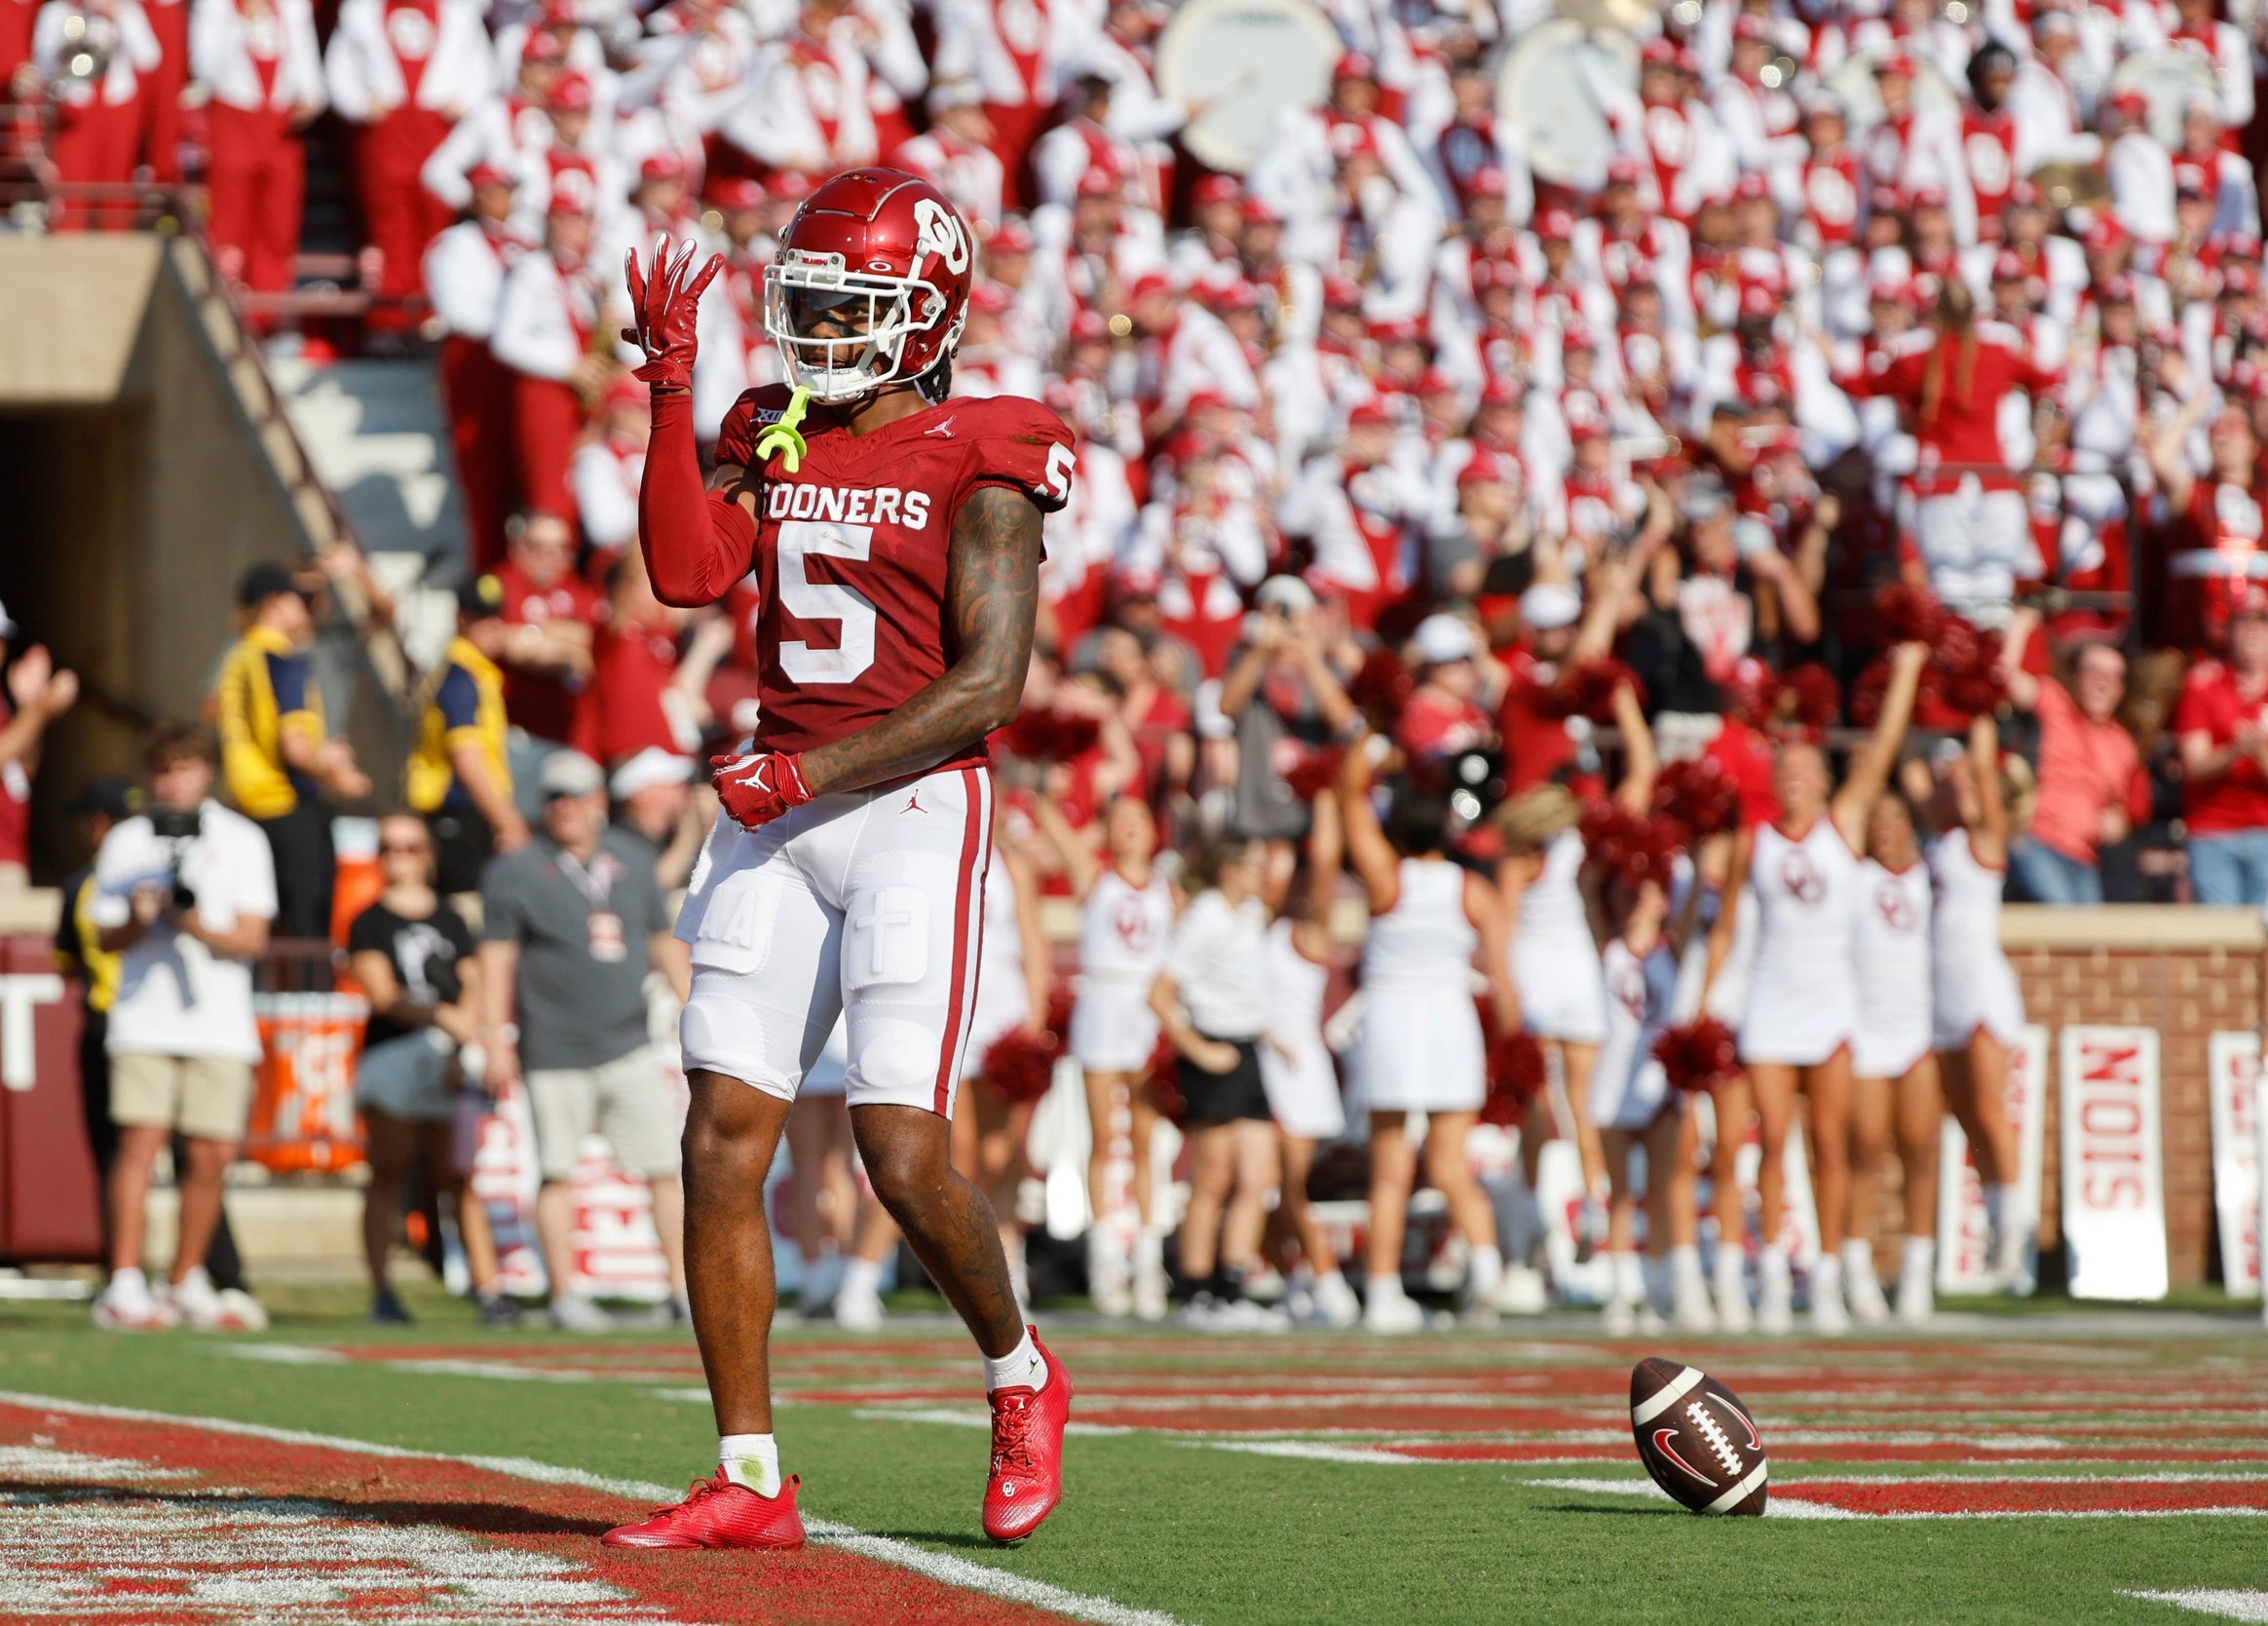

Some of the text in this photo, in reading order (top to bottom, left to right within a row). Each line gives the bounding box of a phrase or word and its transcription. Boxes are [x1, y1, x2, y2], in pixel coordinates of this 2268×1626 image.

[914, 198, 968, 275] OU
[1035, 441, 1077, 503] 5
[764, 482, 931, 530] OONERS
[777, 520, 876, 684] 5
[1002, 1481, 1016, 1497] OU
